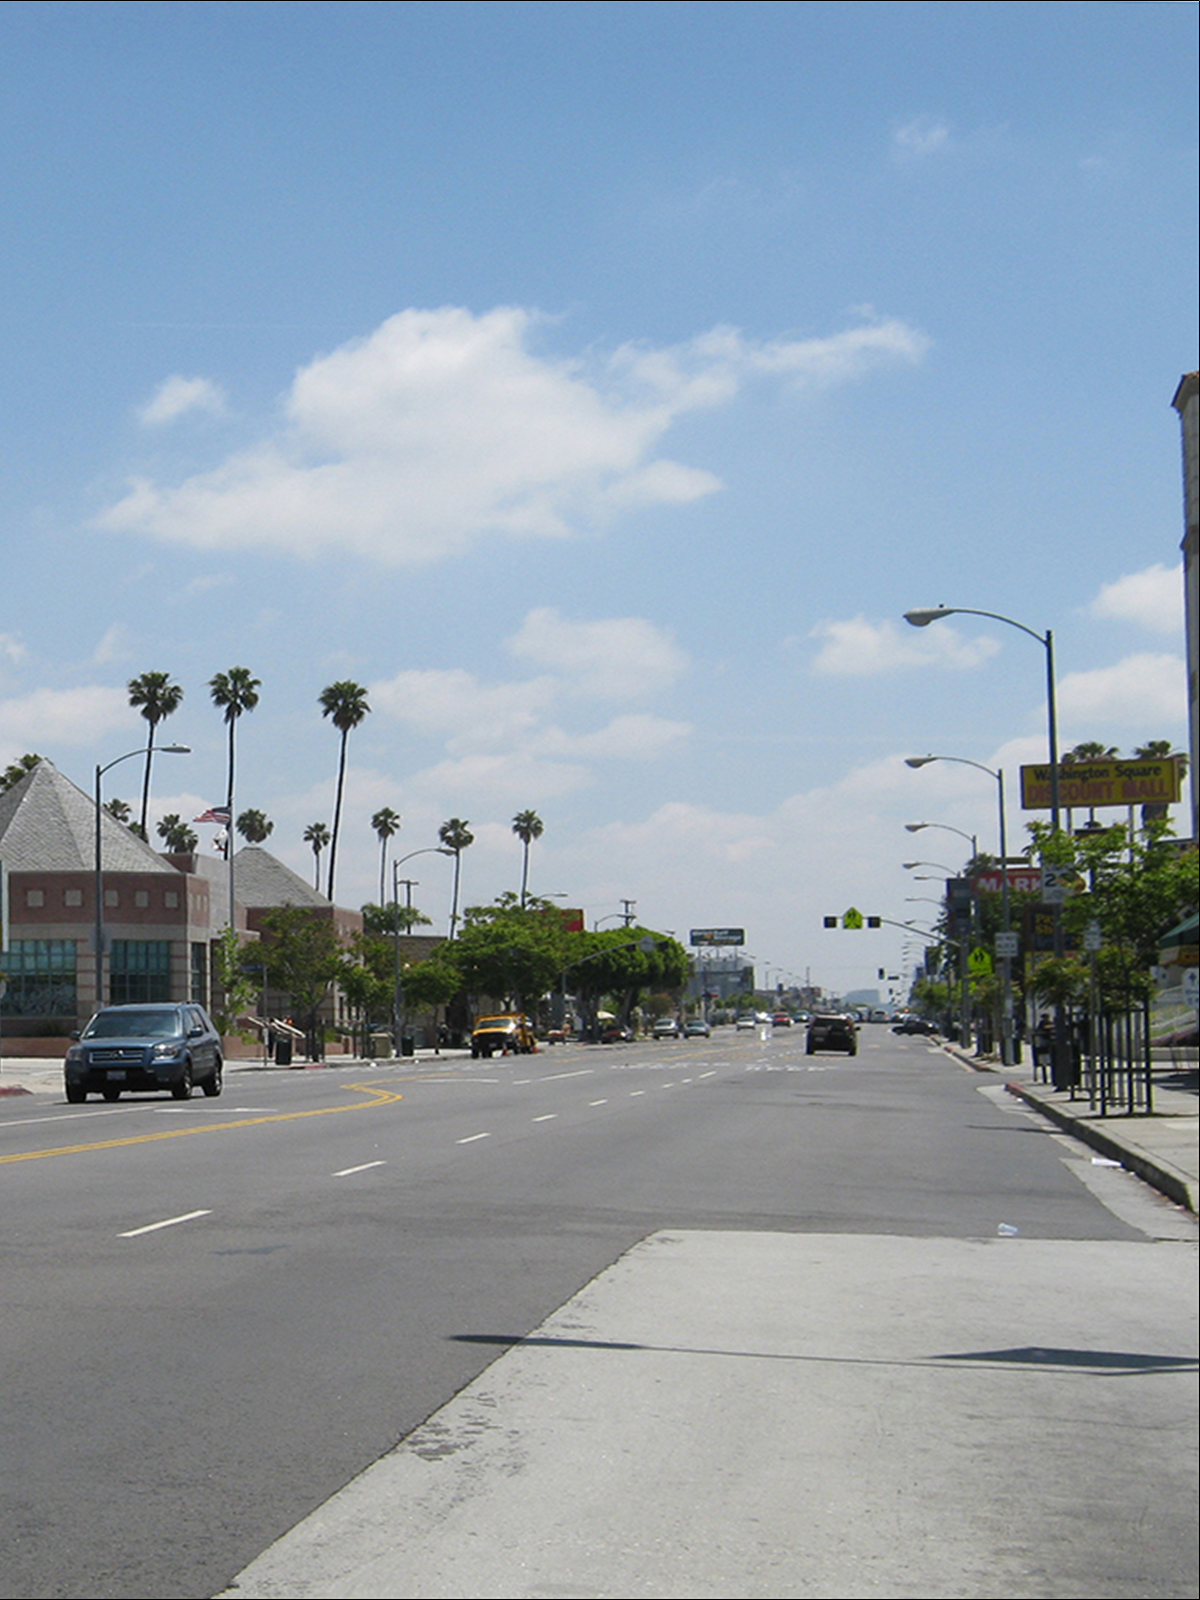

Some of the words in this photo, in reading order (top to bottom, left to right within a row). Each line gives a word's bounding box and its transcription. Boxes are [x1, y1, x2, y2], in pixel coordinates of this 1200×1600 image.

[1034, 766, 1109, 783] Wahington
[1115, 764, 1162, 780] Square
[1122, 779, 1169, 798] MALL
